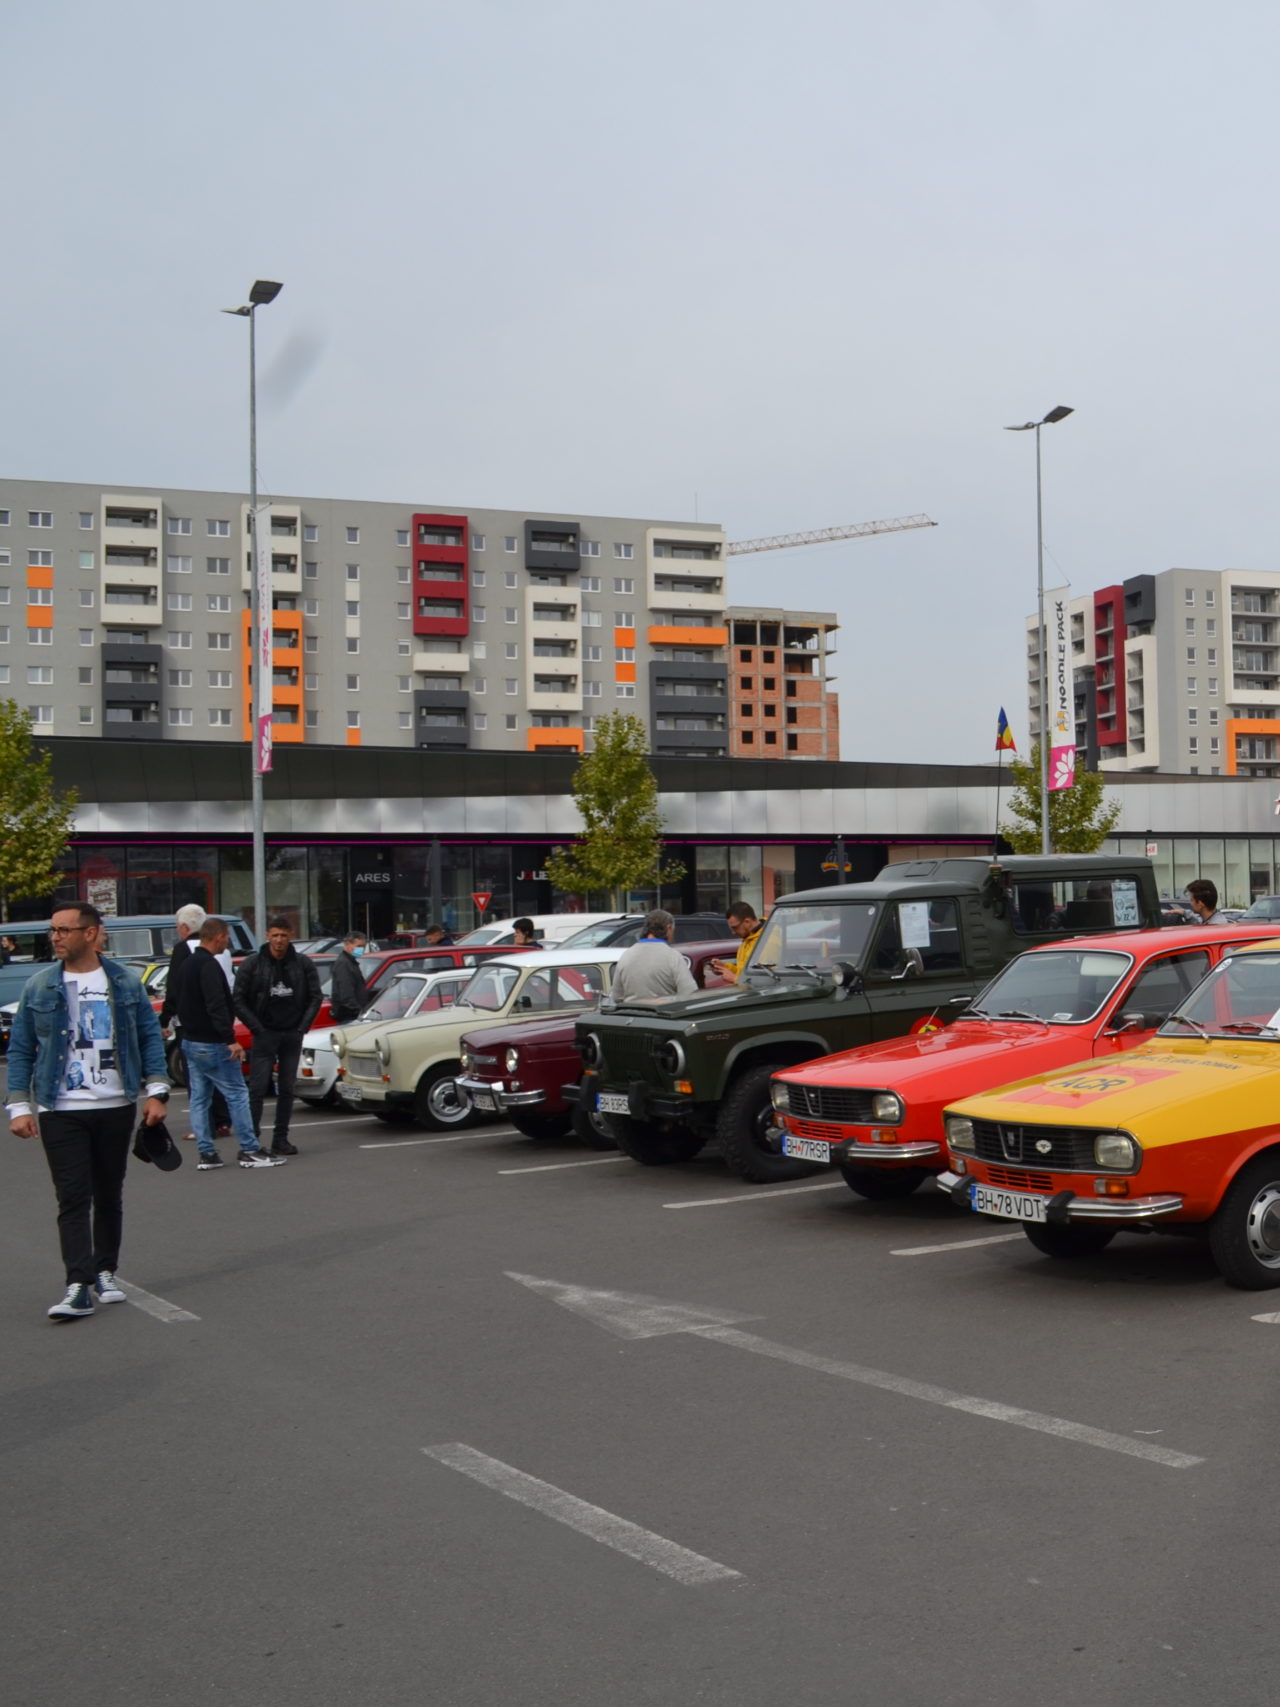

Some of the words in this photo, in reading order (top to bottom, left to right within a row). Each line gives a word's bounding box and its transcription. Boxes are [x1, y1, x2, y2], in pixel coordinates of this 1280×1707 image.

[1055, 600, 1065, 640] PACK
[1057, 644, 1068, 709] NOODLE
[355, 873, 391, 883] ARES
[1051, 1076, 1127, 1091] ACR
[786, 1138, 798, 1156] BH
[977, 1190, 993, 1212] BH
